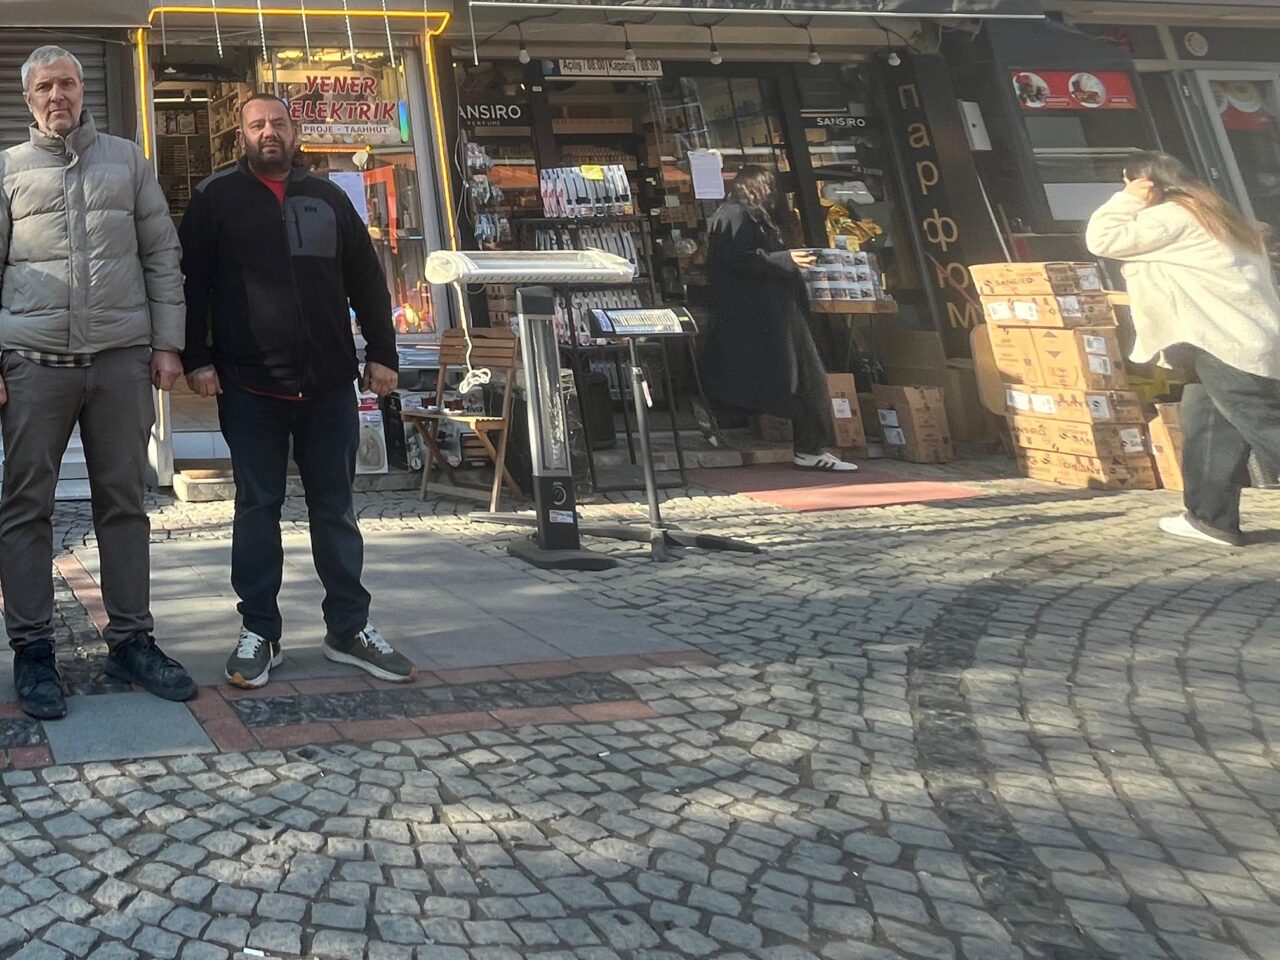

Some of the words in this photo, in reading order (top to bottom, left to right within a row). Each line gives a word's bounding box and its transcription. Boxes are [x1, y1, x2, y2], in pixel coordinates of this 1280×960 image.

[306, 75, 377, 96] YENER
[290, 97, 397, 121] ELEKTRİK
[303, 125, 333, 133] PROJE
[816, 117, 866, 127] SANSIRO
